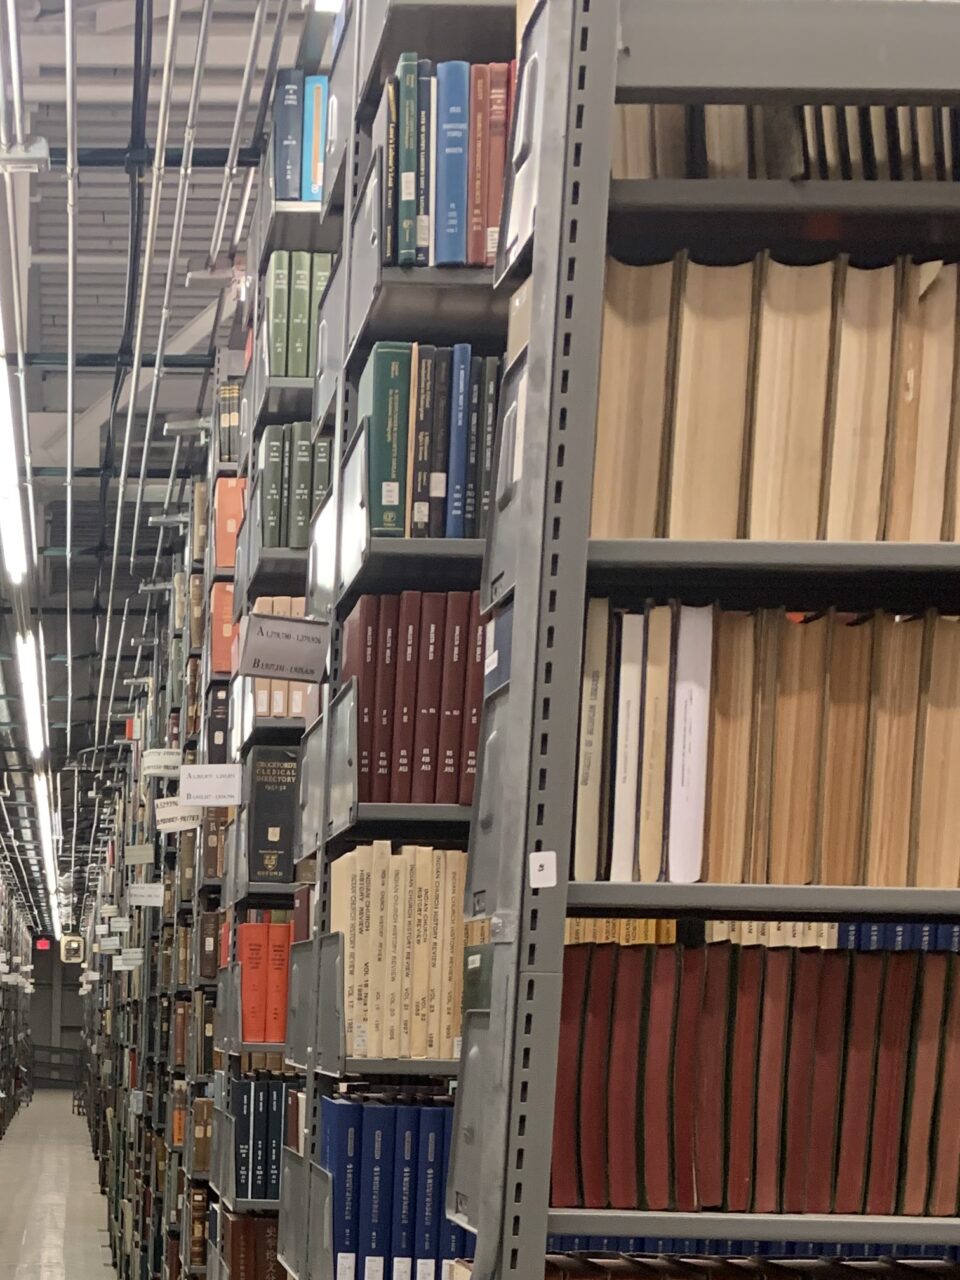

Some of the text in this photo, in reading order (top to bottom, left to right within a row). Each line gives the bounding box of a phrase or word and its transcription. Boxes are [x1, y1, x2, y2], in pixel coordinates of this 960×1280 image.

[257, 626, 264, 636] A
[252, 658, 260, 669] B
[186, 772, 193, 780] A
[256, 768, 296, 776] CLERICAL
